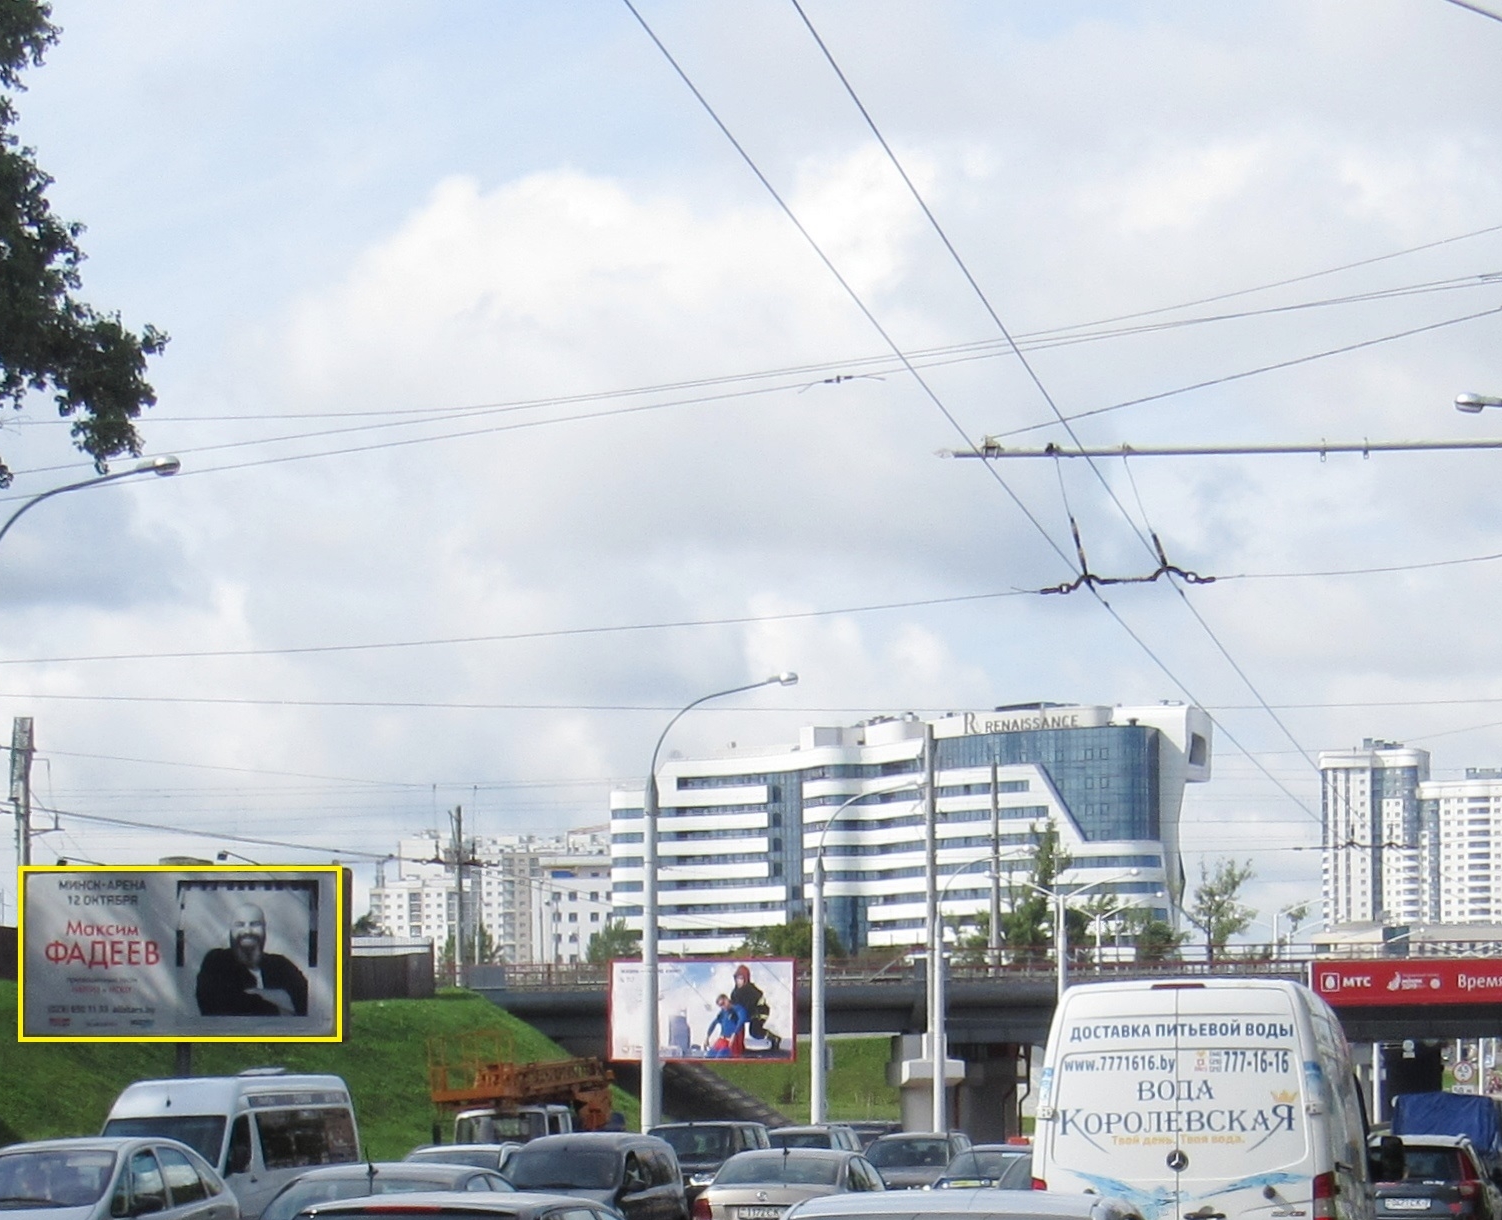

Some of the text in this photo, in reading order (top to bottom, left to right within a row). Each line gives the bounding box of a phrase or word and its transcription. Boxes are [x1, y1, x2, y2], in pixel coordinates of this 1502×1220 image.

[985, 715, 1079, 733] RENAISSANCE
[58, 880, 147, 891] МИНСК-АРЕНА
[68, 895, 139, 906] 12 ОКТЯБРЯ
[66, 920, 139, 937] Максим
[45, 940, 161, 970] ФАДЕЕВ
[1342, 976, 1372, 987] МТС
[1070, 1019, 1294, 1043] ДОСТАВКА ПИТЬЕВОЙ ВОДЫ
[1064, 1054, 1176, 1074] www.7771616.by
[1223, 1051, 1289, 1074] 777-16-16
[1137, 1079, 1215, 1101] ВОДА
[1111, 1133, 1246, 1147] Твой день. Твоя вода.
